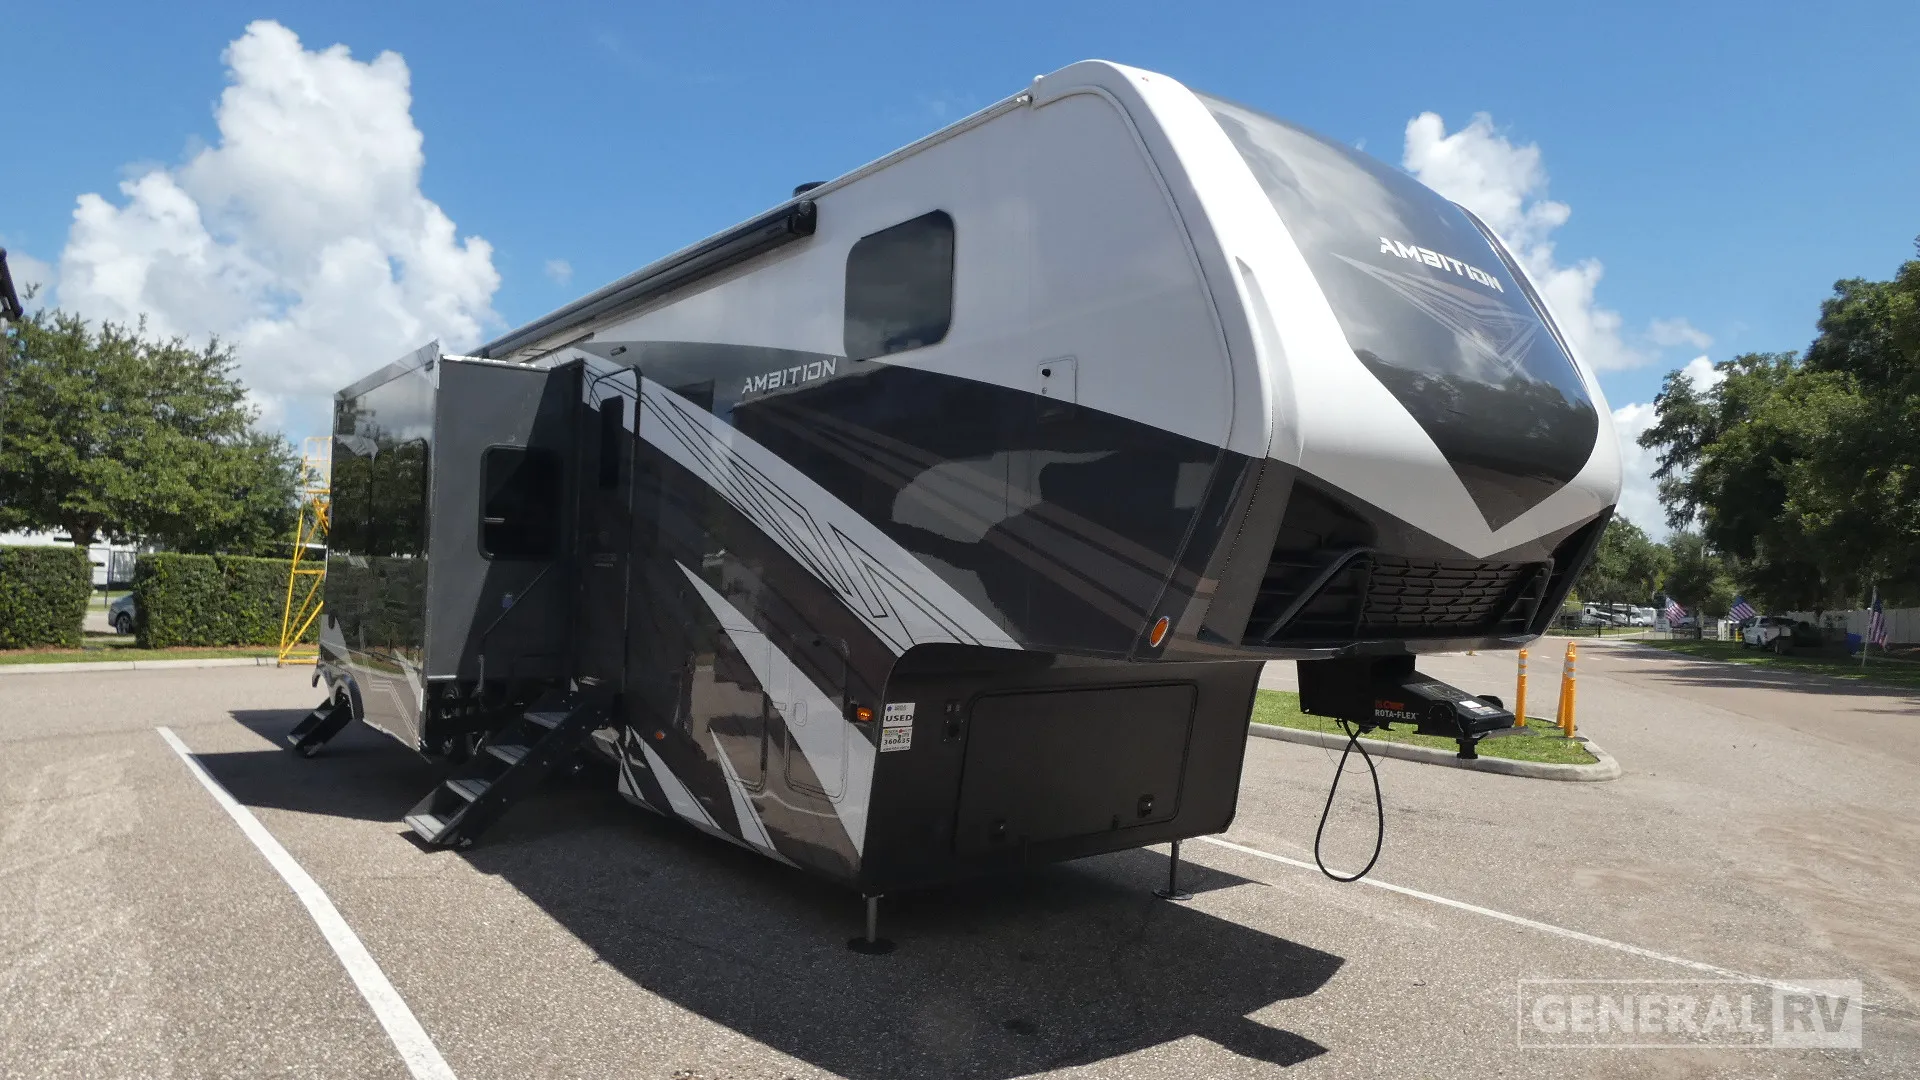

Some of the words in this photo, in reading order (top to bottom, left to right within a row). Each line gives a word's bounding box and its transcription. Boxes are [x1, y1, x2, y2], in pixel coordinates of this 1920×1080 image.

[1379, 236, 1504, 293] AMBITION
[741, 357, 837, 394] AMBITION
[885, 714, 913, 722] USED
[1374, 709, 1417, 720] ROTA-FLEX
